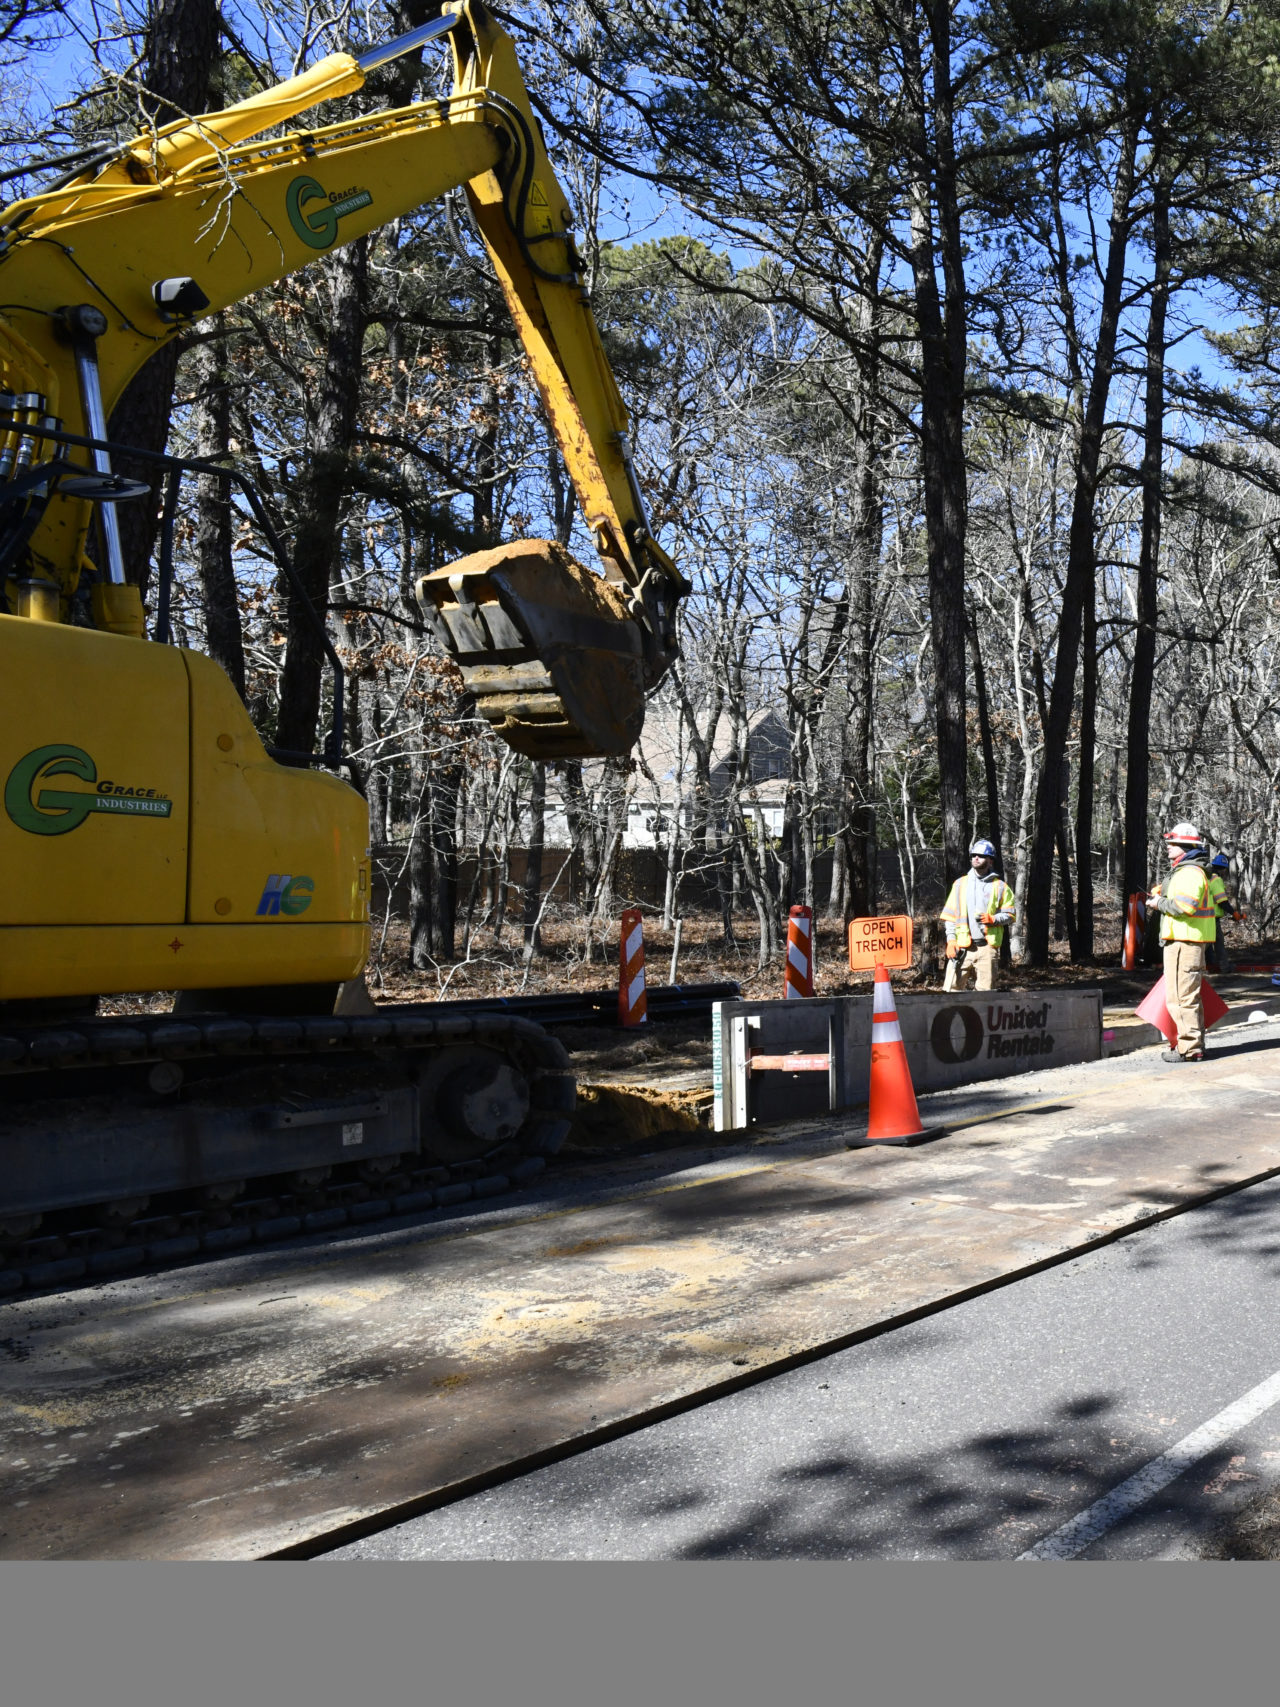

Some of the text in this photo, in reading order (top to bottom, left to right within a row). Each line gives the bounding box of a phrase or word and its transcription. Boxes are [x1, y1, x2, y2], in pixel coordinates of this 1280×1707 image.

[334, 193, 370, 215] INDUSTRIES
[96, 798, 168, 812] INDUSTRIES
[862, 920, 895, 936] OPEN
[855, 936, 903, 953] TRENCH
[987, 1003, 1048, 1032] United
[987, 1031, 1055, 1059] Rentals
